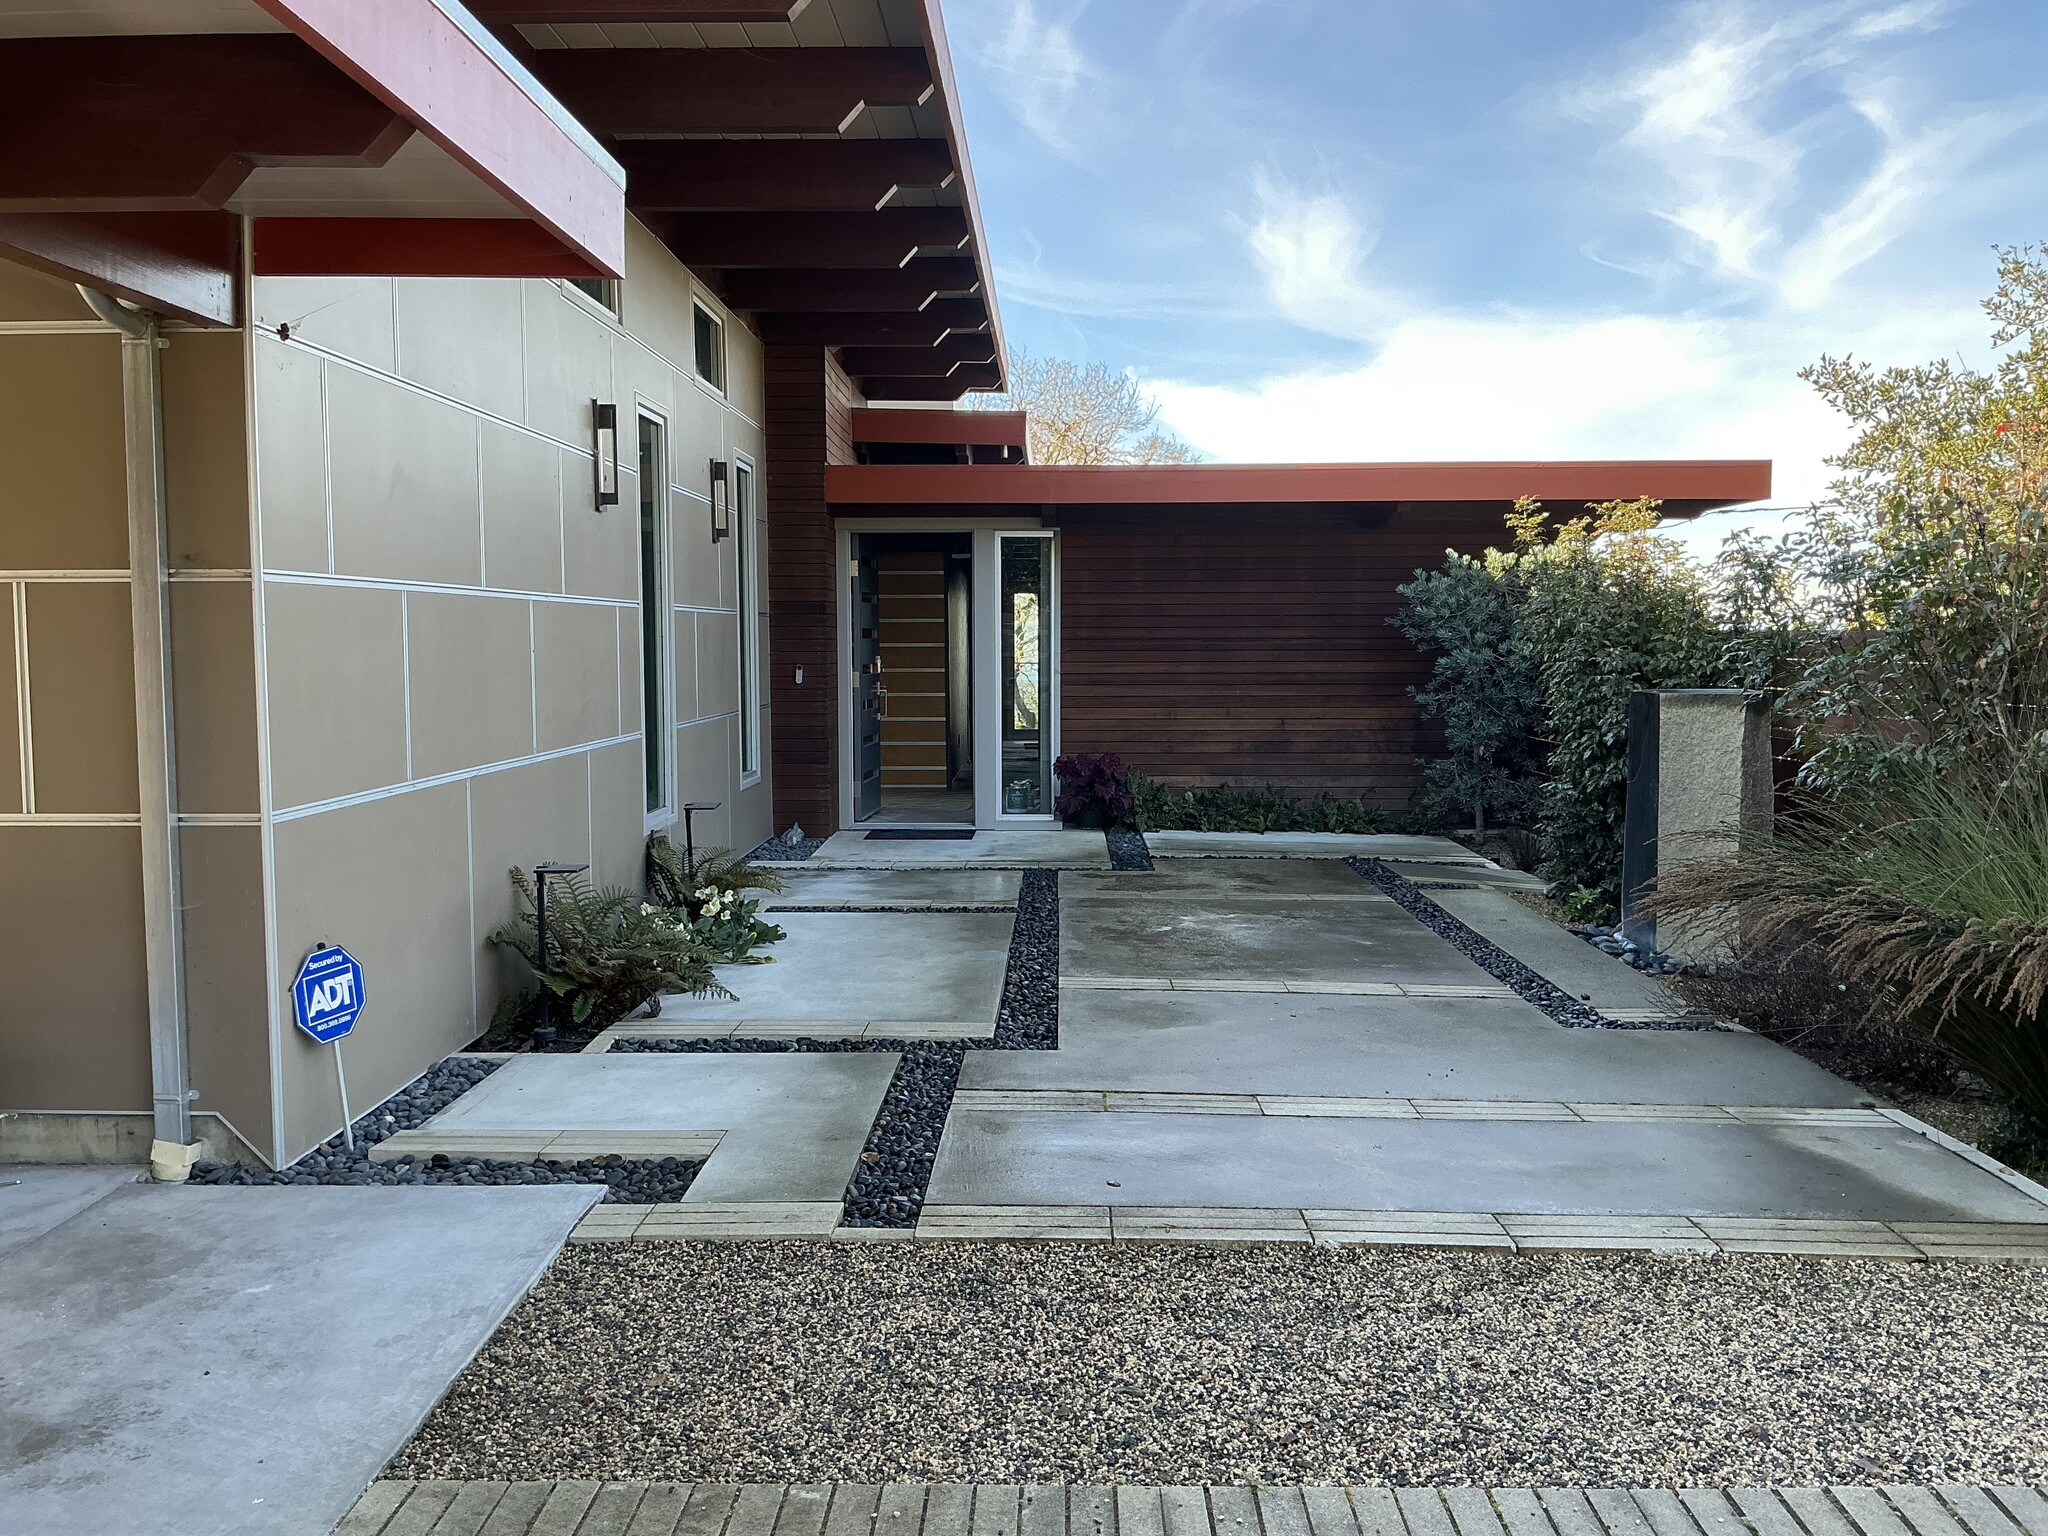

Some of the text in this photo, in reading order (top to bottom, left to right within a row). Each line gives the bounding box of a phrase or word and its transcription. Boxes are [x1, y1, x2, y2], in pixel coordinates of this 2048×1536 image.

[309, 954, 343, 970] Secured by
[309, 973, 352, 1018] ADT
